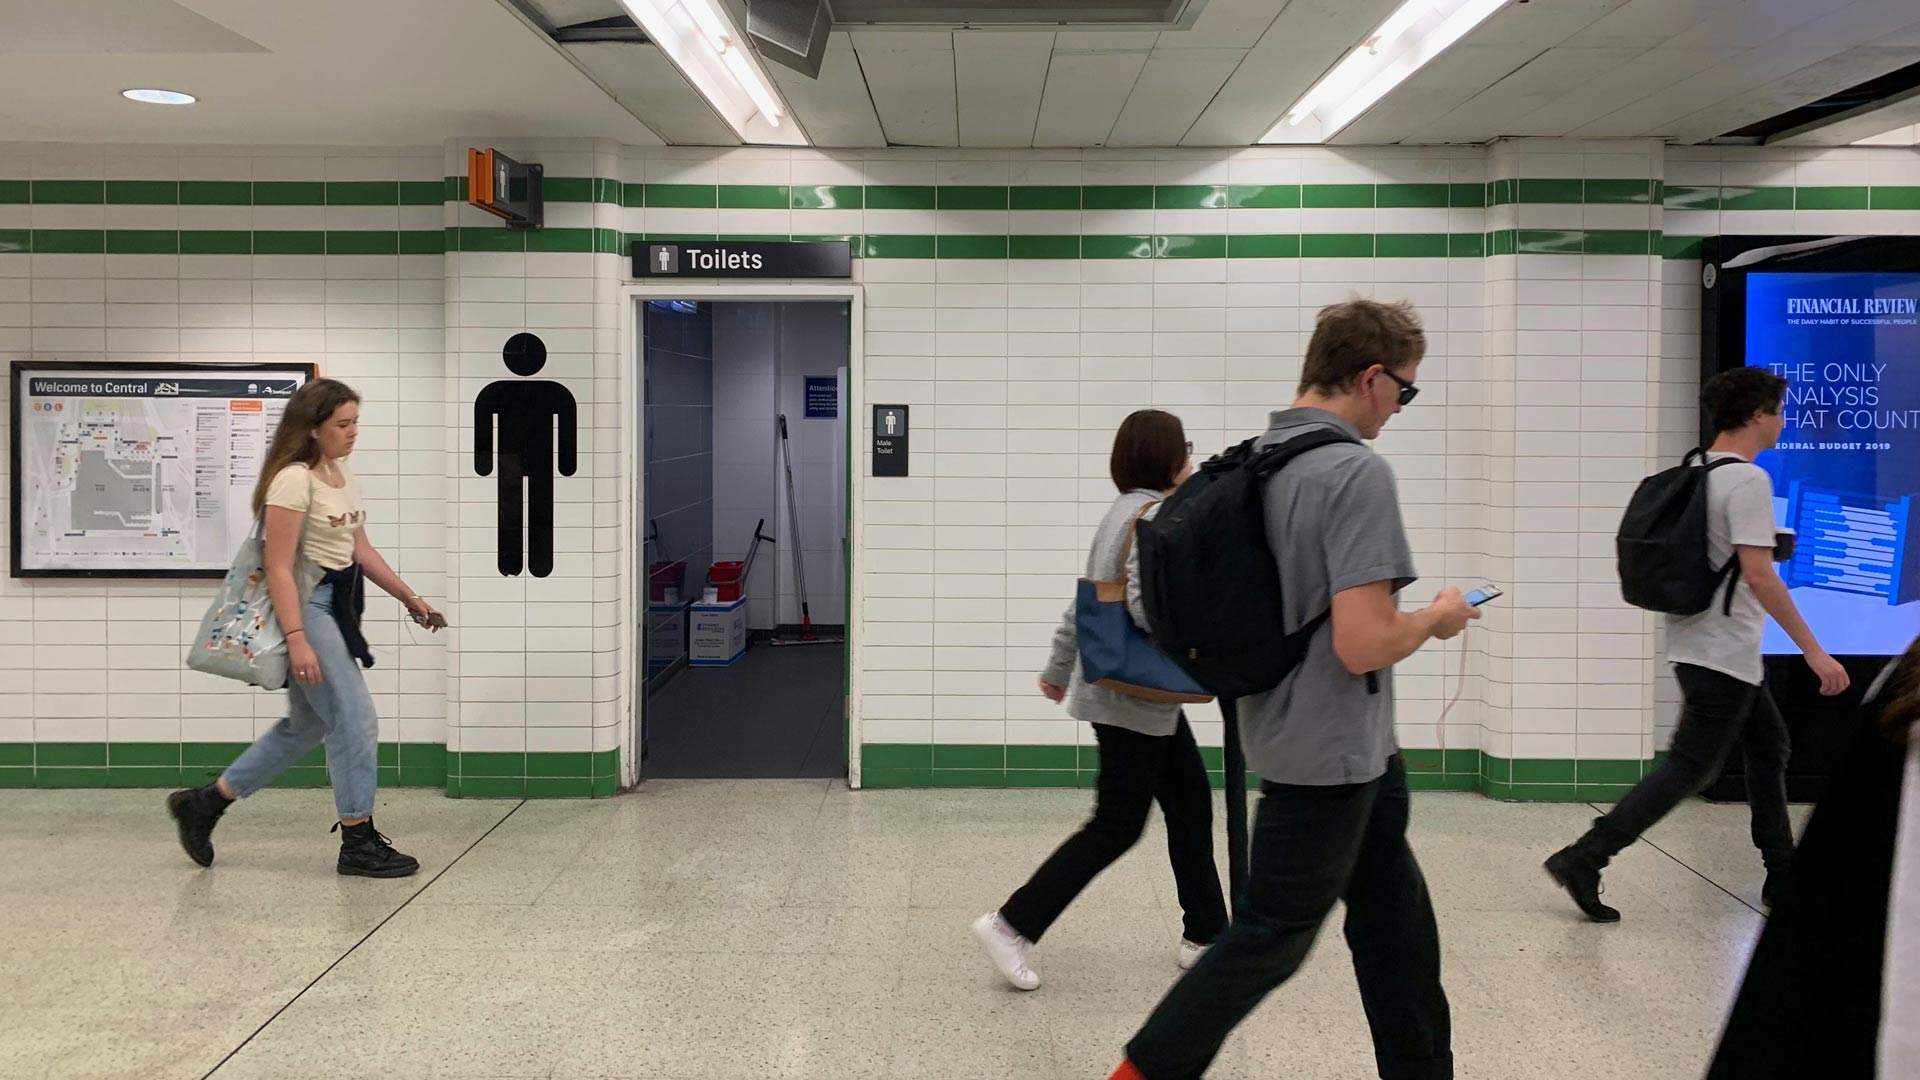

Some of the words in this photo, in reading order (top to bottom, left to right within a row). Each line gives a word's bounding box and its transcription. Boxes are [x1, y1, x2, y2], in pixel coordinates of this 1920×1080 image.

[686, 248, 763, 270] Toilets
[1787, 298, 1860, 314] FINANCIAL
[1864, 298, 1918, 314] REVIEW
[1769, 363, 1815, 382] THE
[1823, 363, 1887, 382] ONLY
[35, 381, 88, 393] Welcome
[91, 382, 102, 393] to
[105, 382, 148, 393] Central
[1782, 386, 1879, 406] NALYSIS
[1783, 410, 1829, 429] HAT
[1775, 442, 1815, 450] EDERAL
[1819, 442, 1862, 450] BUDGET
[1865, 442, 1891, 450] 2019
